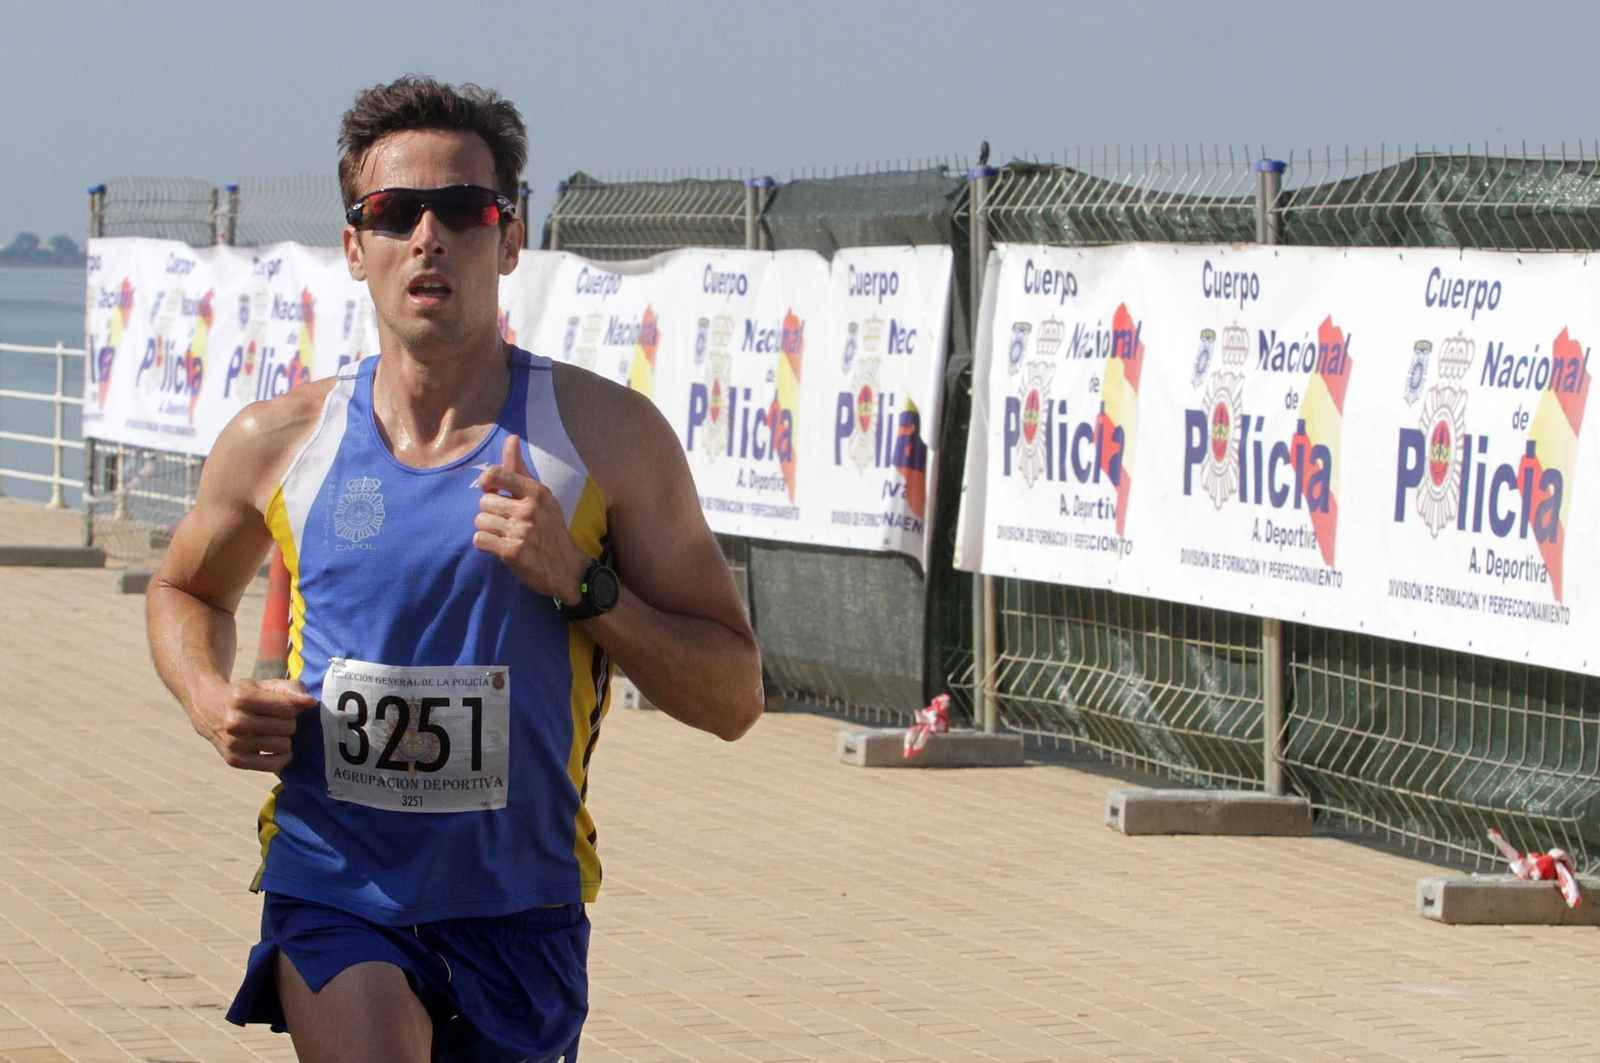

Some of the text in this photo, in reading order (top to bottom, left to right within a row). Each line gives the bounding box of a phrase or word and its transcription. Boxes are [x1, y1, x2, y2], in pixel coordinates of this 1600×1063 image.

[576, 266, 622, 302] Cuerpo
[848, 264, 899, 304] Cuerpo
[1024, 258, 1078, 305] Cuerpo
[1203, 260, 1260, 310] Cuerpo
[1425, 266, 1502, 321] Cuerpo
[1256, 329, 1352, 376] Nacional
[1479, 341, 1591, 395] Nacional
[1284, 385, 1299, 411] de
[1512, 404, 1529, 430] de
[335, 542, 377, 551] CAPOL
[1252, 517, 1317, 552] A. Deportiva
[1468, 547, 1548, 584] A. Deportiva
[1423, 585, 1435, 604] DE
[374, 676, 419, 687] GENERAL
[421, 679, 433, 687] DE
[437, 678, 450, 687] LA
[452, 676, 490, 687] POLICÍA
[337, 690, 482, 773] 3251
[333, 767, 504, 791] AGRUPACIÓN DEPORTIVA
[401, 794, 423, 808] 3251
